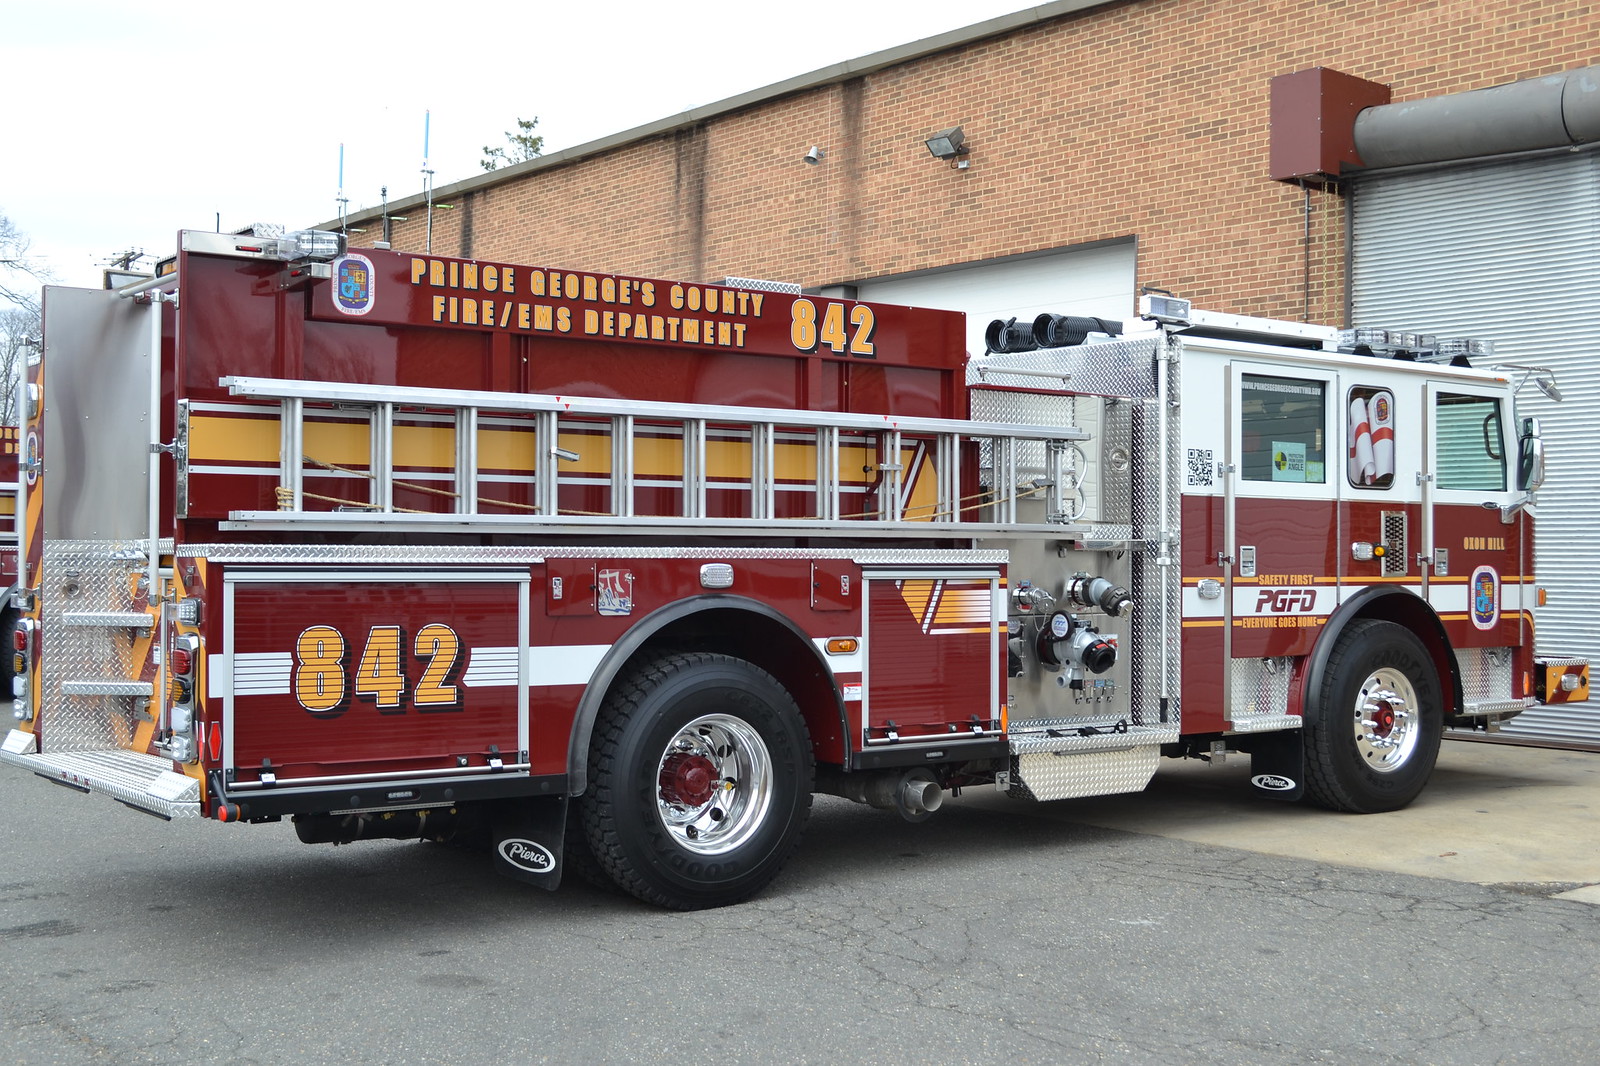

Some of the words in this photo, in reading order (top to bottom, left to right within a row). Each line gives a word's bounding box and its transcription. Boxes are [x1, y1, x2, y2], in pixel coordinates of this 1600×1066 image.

[411, 258, 514, 293] PRINCE
[530, 270, 655, 307] GEORGE'S
[670, 284, 764, 317] COUNTY
[433, 295, 571, 332] FIRE/EMS
[584, 309, 747, 347] DEPARTMENT
[791, 298, 875, 356] 842
[1288, 463, 1304, 471] ANGLE
[1463, 537, 1485, 550] OXON
[1487, 537, 1505, 550] HILL
[1258, 575, 1290, 586] SAFETY
[1291, 574, 1313, 585] FIRST
[1255, 589, 1317, 613] PGFD
[1242, 617, 1277, 628] EVERYONE
[1278, 617, 1296, 628] GOES
[1297, 616, 1317, 627] HOME
[296, 623, 461, 714] 842
[1261, 775, 1288, 788] Pierce
[509, 842, 548, 868] Pierce
